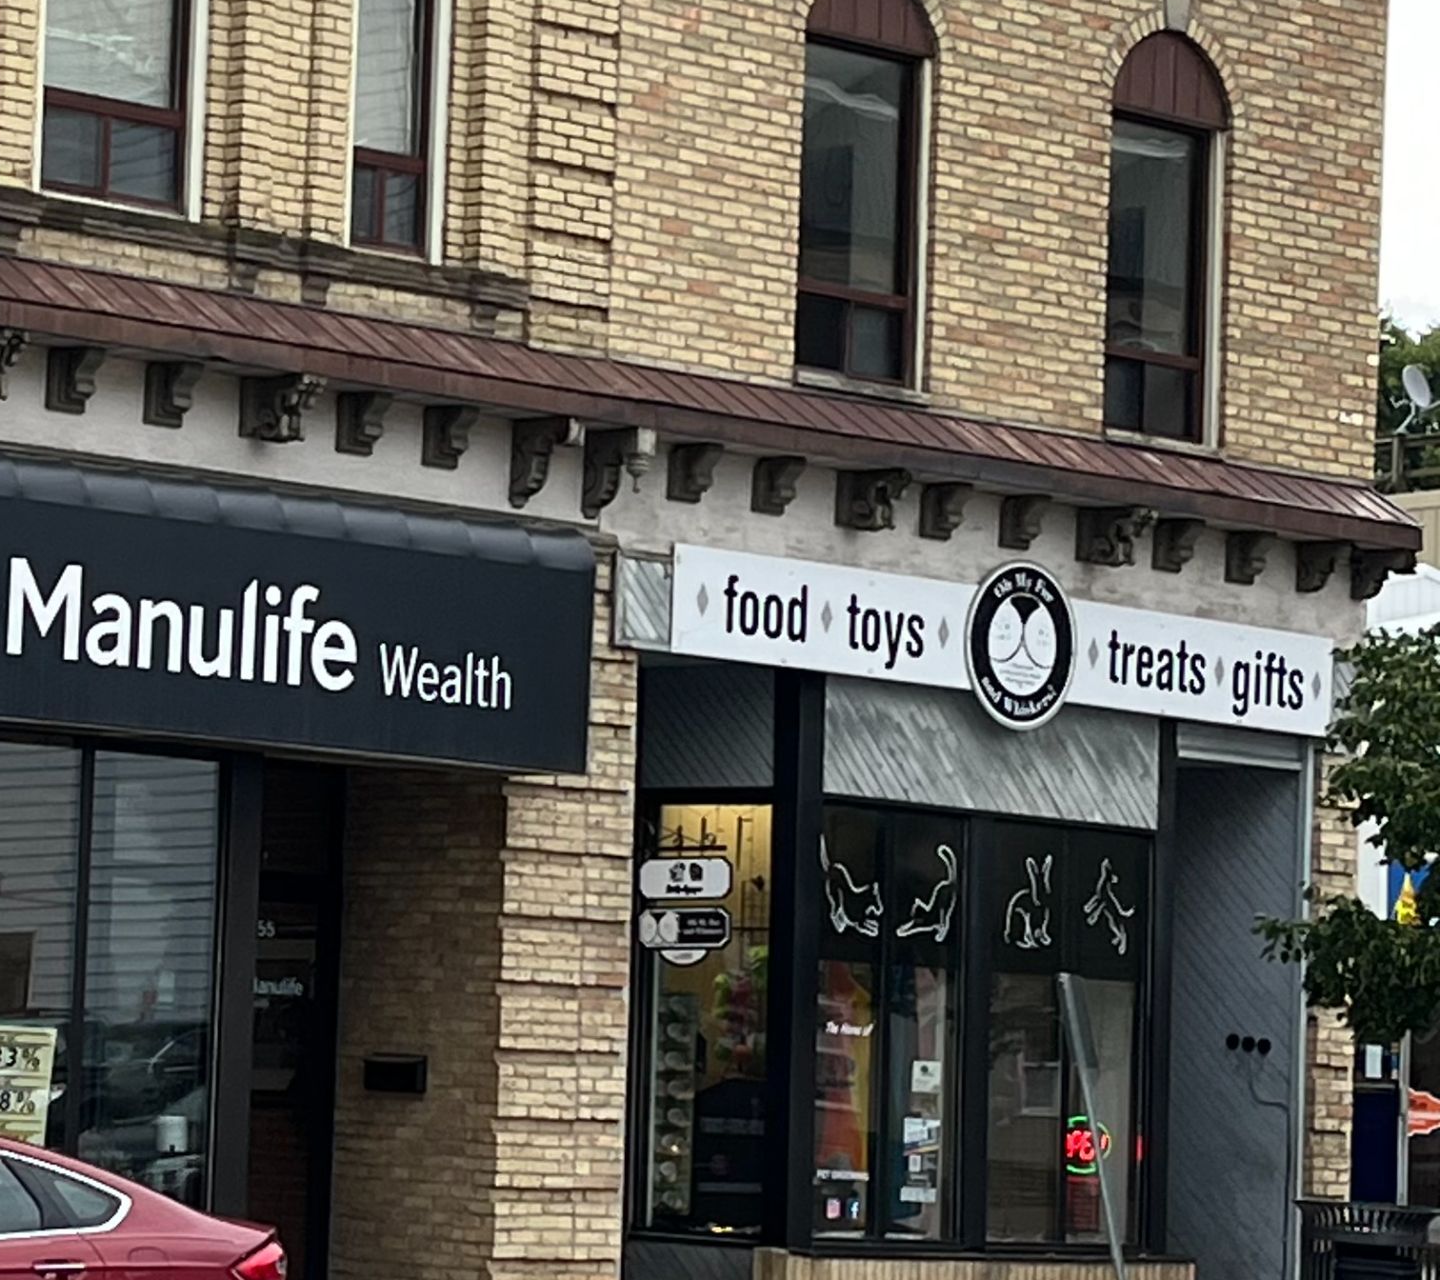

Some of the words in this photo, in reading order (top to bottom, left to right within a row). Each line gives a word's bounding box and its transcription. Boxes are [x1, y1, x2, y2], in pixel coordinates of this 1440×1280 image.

[723, 574, 809, 644] food
[845, 594, 926, 671] toys
[993, 578, 1012, 598] Oh
[1014, 572, 1033, 593] My
[6, 557, 357, 691] Manulife
[379, 643, 513, 711] Wealth
[1107, 629, 1207, 696] treats
[1231, 650, 1305, 717] gifts
